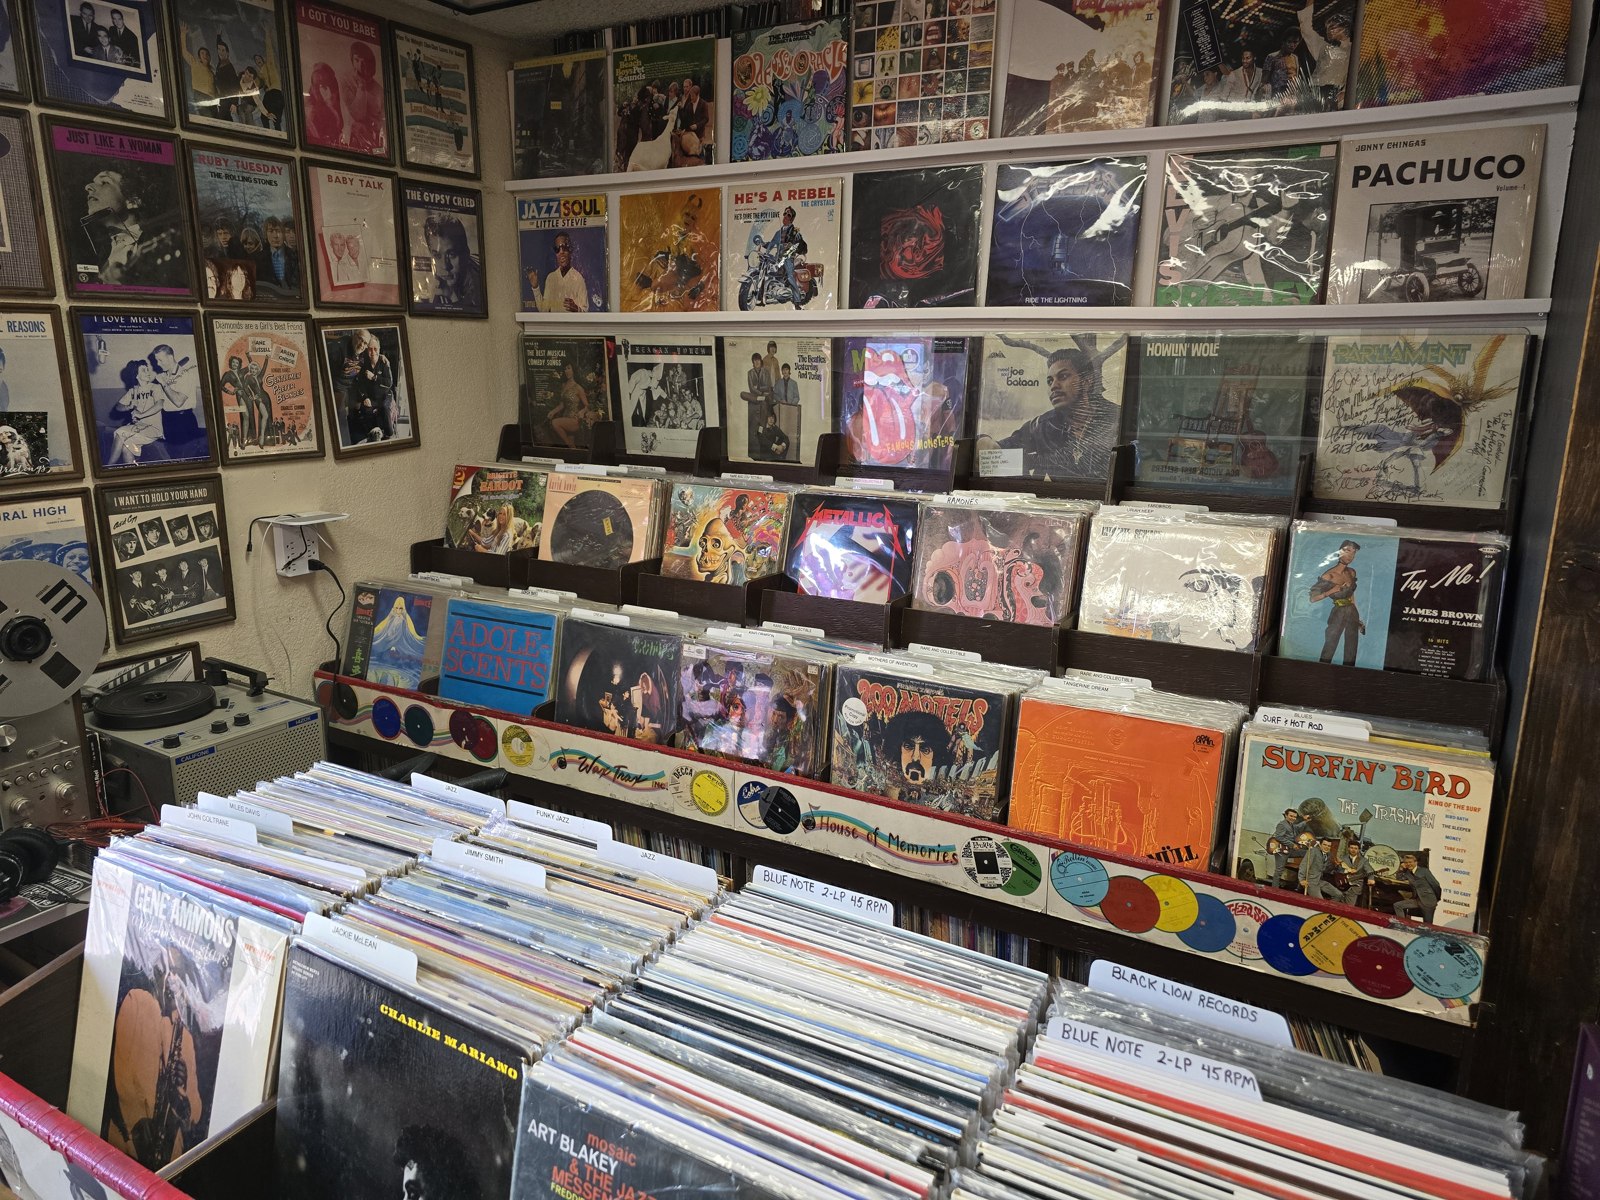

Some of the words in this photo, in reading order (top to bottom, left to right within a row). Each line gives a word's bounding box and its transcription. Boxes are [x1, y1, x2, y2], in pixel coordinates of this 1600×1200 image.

[301, 5, 305, 18] I
[308, 11, 327, 24] GOT
[330, 16, 350, 30] YOU
[353, 22, 376, 38] BABE
[616, 67, 633, 76] Boys
[633, 66, 645, 74] Pet
[619, 60, 642, 69] Beach
[618, 73, 646, 82] Sounds
[67, 130, 90, 144] JUST
[94, 134, 116, 149] LIKE
[119, 138, 125, 149] A
[129, 140, 163, 155] WOMAN
[1355, 142, 1387, 152] JONNY
[1391, 138, 1427, 151] CHINGAS
[198, 154, 229, 168] RUBY
[234, 159, 283, 176] TUESDAY
[1351, 153, 1526, 189] PACHUCO
[209, 171, 224, 180] THE
[224, 174, 254, 184] ROLLING
[253, 177, 278, 187] STONES
[327, 174, 354, 187] BABY
[359, 179, 384, 191] TALK
[406, 189, 422, 201] THE
[423, 192, 450, 205] GYPSY
[452, 196, 475, 208] CRIED
[734, 191, 768, 204] HE'S
[772, 190, 783, 202] A
[788, 187, 836, 200] REBEL
[521, 201, 560, 220] JAZZ
[562, 198, 601, 217] SOUL
[536, 218, 560, 229] LITTLE
[562, 217, 587, 227] STEVIE
[1054, 296, 1088, 304] LIGHTNING
[7, 320, 46, 333] REASONS
[130, 316, 164, 324] MICKEY
[215, 321, 243, 330] Diamonds
[274, 322, 286, 331] Best
[287, 323, 303, 331] Friend
[1146, 342, 1190, 357] HOWLIN'
[1191, 342, 1220, 357] WOLF
[1332, 341, 1472, 368] PARLIAMENT
[794, 362, 819, 372] Yesterday
[798, 354, 807, 363] The
[807, 354, 826, 364] Beatles
[808, 371, 823, 382] Today
[1007, 378, 1039, 387] bataan
[887, 438, 915, 453] FAMOUS
[918, 435, 955, 450] MONSTERS
[480, 480, 523, 491] BARDOT
[118, 495, 140, 506] WANT
[140, 494, 150, 504] TO
[151, 491, 170, 503] HOLD
[170, 489, 188, 500] YOUR
[189, 488, 208, 499] HAND
[947, 497, 979, 505] RAMONES
[793, 500, 905, 561] METALLICA
[1400, 569, 1428, 599] Try
[1402, 607, 1438, 617] JAMES
[1441, 610, 1484, 621] BROWN
[449, 619, 551, 657] ADOLE-
[445, 649, 547, 689] SCENTS
[868, 656, 888, 664] MOTHERS
[894, 659, 918, 668] INVENTION
[1063, 680, 1090, 689] TANGERINE
[1090, 684, 1109, 692] DREAM
[1103, 674, 1134, 683] COLLECTIBLE
[857, 679, 898, 723] 200
[896, 688, 988, 738] MOTELS
[1262, 714, 1282, 724] SURF
[1290, 719, 1305, 729] HOT
[1308, 721, 1323, 731] ROD
[180, 750, 211, 763] CALIFONE
[578, 755, 612, 779] Wax
[611, 765, 649, 787] Trax
[673, 766, 693, 780] DECCA
[445, 784, 457, 793] JAZZ
[1392, 765, 1471, 799] BiRD
[742, 783, 761, 799] Cobra
[229, 802, 244, 813] MILES
[244, 806, 261, 817] DAVIS
[1338, 797, 1359, 816] THE
[1372, 804, 1435, 829] TRASHMEN
[1428, 799, 1443, 808] KING
[1453, 803, 1464, 811] THE
[1466, 805, 1482, 813] SURF
[187, 812, 201, 821] JOHN
[201, 814, 230, 827] COLTRANE
[536, 809, 554, 821] FUNKY
[555, 814, 570, 824] JAZZ
[1452, 825, 1471, 833] SLEEPER
[819, 816, 859, 839] House
[866, 827, 880, 847] of
[888, 832, 959, 866] Memories
[465, 848, 484, 860] JIMMY
[484, 852, 504, 865] SMITH
[641, 851, 656, 861] JAZZ
[763, 869, 788, 886] BLUE
[790, 878, 815, 894] NOTE
[822, 887, 846, 903] 2-LP
[851, 896, 863, 908] 45
[866, 899, 888, 914] RPM
[134, 882, 168, 918] GENE
[170, 897, 236, 948] AMMONS
[332, 926, 353, 941] JACKIE
[353, 933, 377, 950] McLEAN
[1111, 966, 1157, 991] BLACK
[1163, 982, 1193, 1002] LION
[1198, 994, 1259, 1023] RECORDS
[380, 1004, 441, 1041] CHARLIE
[443, 1034, 519, 1081] MARIANO
[1061, 1022, 1100, 1048] BLUE
[1105, 1037, 1144, 1059] NOTE
[1157, 1050, 1193, 1072] 2-LP
[1202, 1063, 1220, 1081] 45
[1224, 1069, 1257, 1092] RPM
[527, 1118, 557, 1146] ART
[560, 1132, 619, 1175] BLAKEY
[586, 1132, 637, 1167] mosaic
[569, 1157, 579, 1174] &
[583, 1163, 613, 1190] THE
